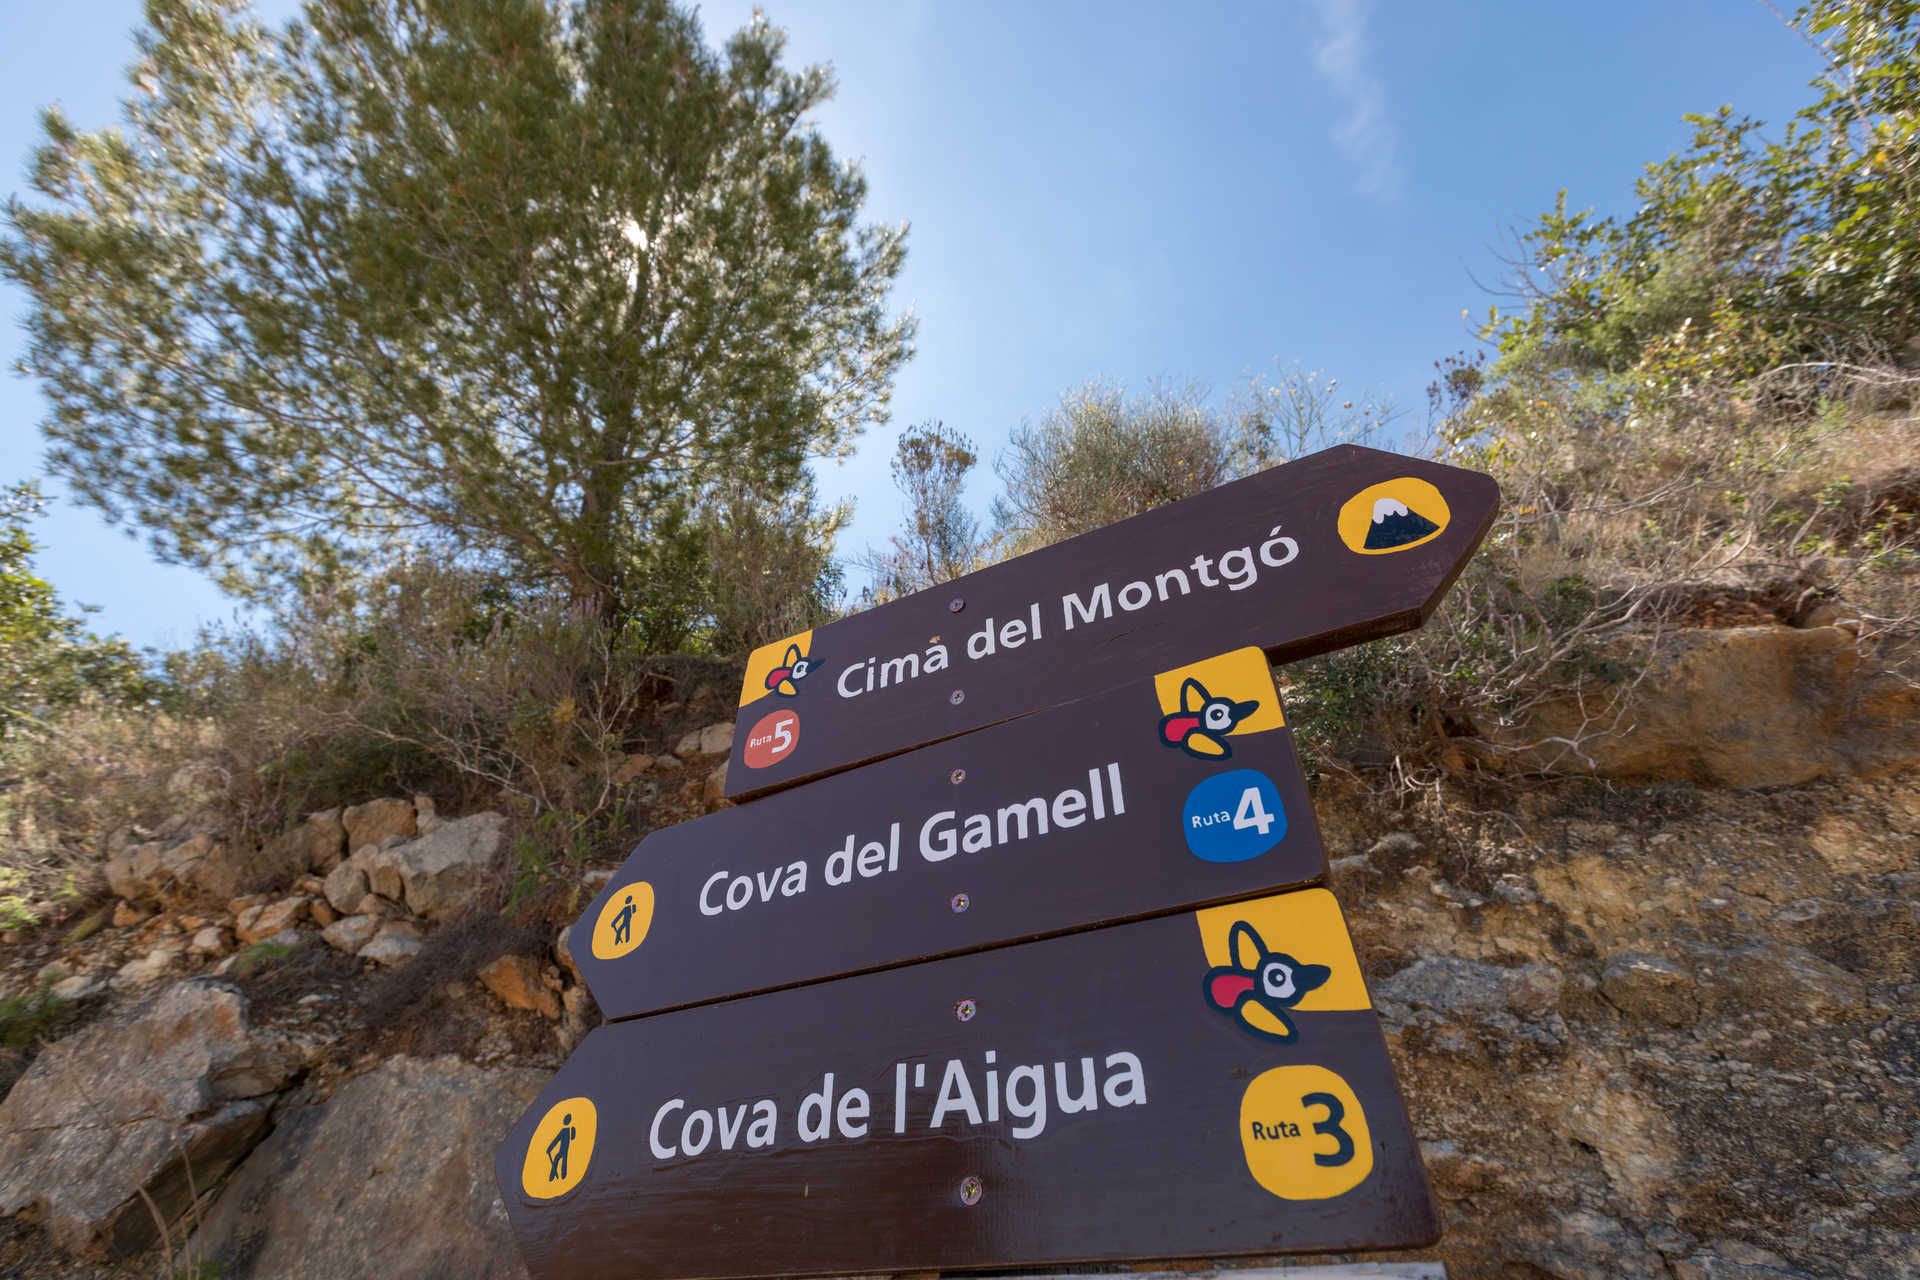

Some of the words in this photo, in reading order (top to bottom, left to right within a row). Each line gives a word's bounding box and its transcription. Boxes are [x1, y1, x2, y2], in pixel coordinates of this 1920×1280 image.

[837, 644, 949, 698] Cima
[967, 602, 1042, 660] del
[1062, 525, 1300, 631] Montgó
[750, 735, 772, 748] Ruta
[771, 718, 794, 753] 5
[699, 860, 808, 916] Cova
[824, 822, 900, 886] del
[919, 762, 1125, 862] Gamell
[1191, 811, 1231, 828] Ruta
[1233, 786, 1275, 835] 4
[649, 1098, 778, 1160] Cova
[797, 1072, 870, 1143] de
[894, 1050, 1147, 1140] l'Aigua
[1251, 1121, 1302, 1141] Ruta
[1301, 1092, 1356, 1168] 3
